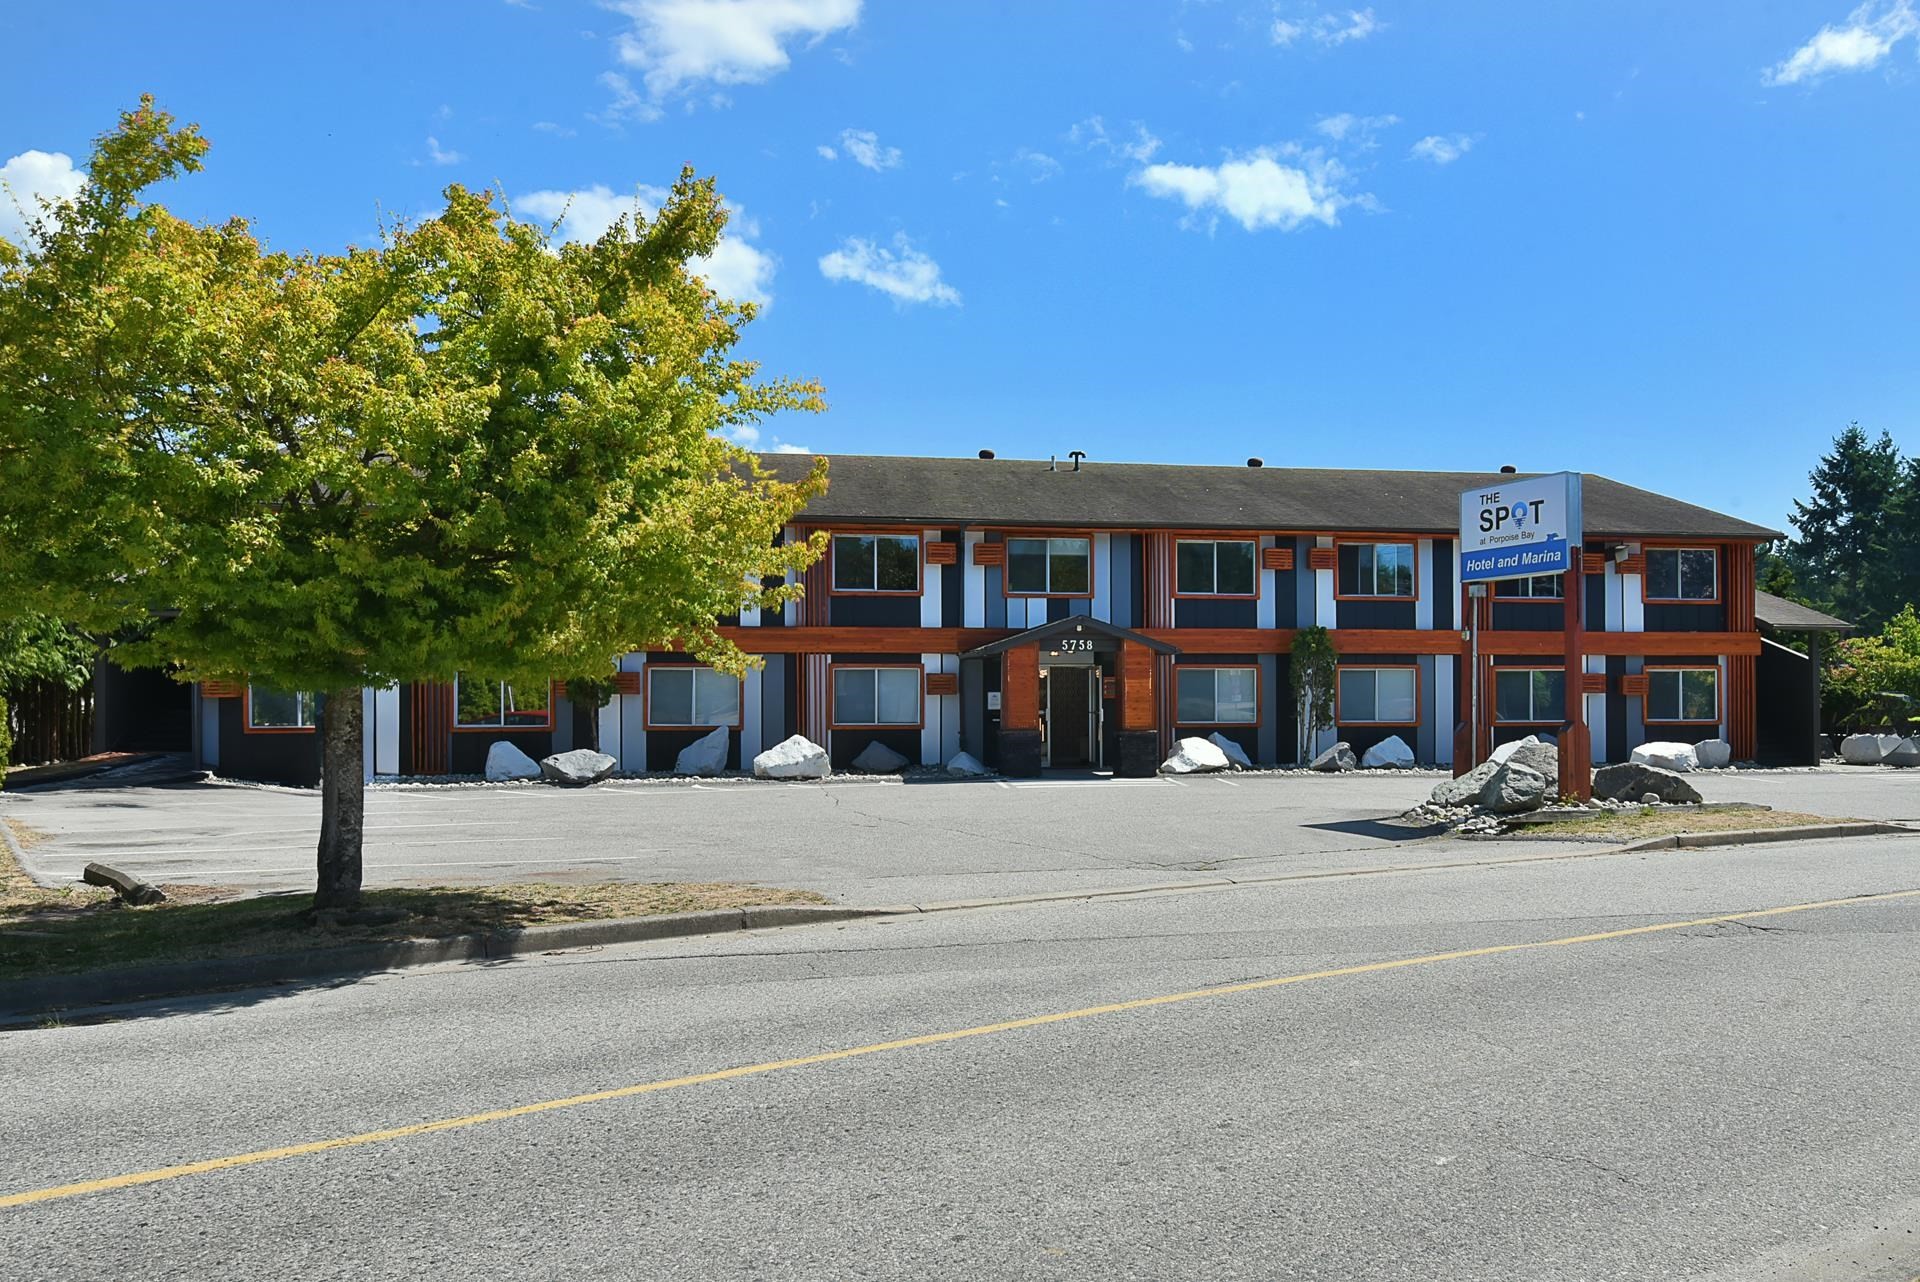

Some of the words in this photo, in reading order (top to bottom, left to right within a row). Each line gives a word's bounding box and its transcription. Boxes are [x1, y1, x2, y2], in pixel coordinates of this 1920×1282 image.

[1480, 492, 1500, 505] THE
[1480, 500, 1544, 532] SPOT
[1489, 535, 1519, 544] Porpoise
[1521, 531, 1535, 540] Bay
[1467, 557, 1494, 571] Hotel
[1497, 554, 1518, 568] and
[1521, 550, 1561, 565] Marina
[1062, 640, 1093, 650] 5758
